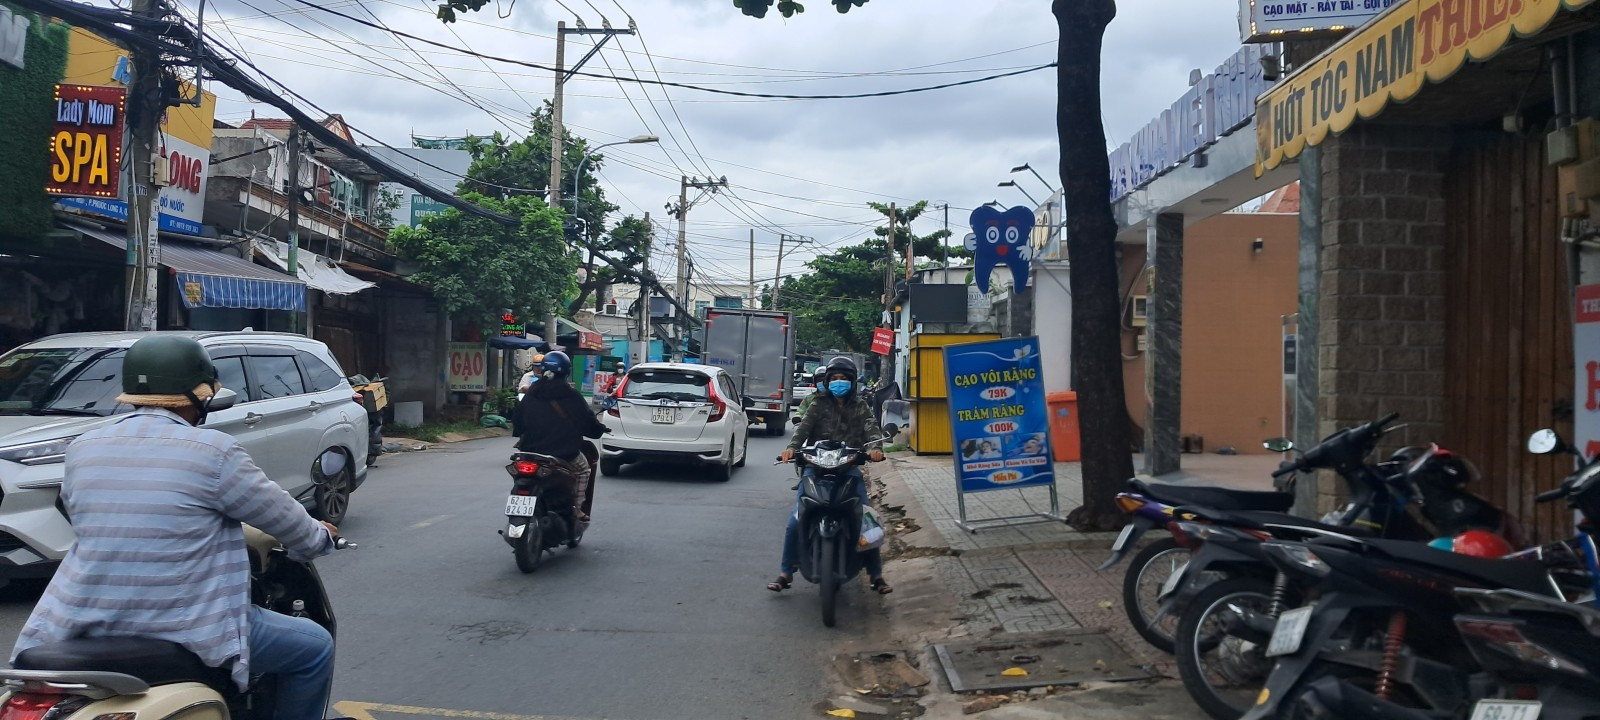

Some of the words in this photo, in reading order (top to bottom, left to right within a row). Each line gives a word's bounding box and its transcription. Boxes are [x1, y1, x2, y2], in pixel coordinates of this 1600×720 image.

[1263, 4, 1283, 17] CẠO
[1340, 0, 1354, 11] TAI
[1273, 83, 1305, 150] HỚT
[1310, 58, 1348, 127] TÓC
[1354, 15, 1415, 103] NAM
[57, 97, 84, 126] Lady
[87, 99, 114, 125] Mom
[52, 131, 109, 186] SPA
[161, 147, 202, 194] ONG
[451, 351, 484, 381] GẠO
[954, 373, 978, 388] CẠO
[980, 369, 1001, 384] VÔI
[1003, 367, 1036, 382] RĂNG
[988, 388, 1007, 398] 79K
[957, 406, 989, 421] TRÁM
[992, 404, 1025, 418] RĂNG
[989, 422, 1014, 433] 100K
